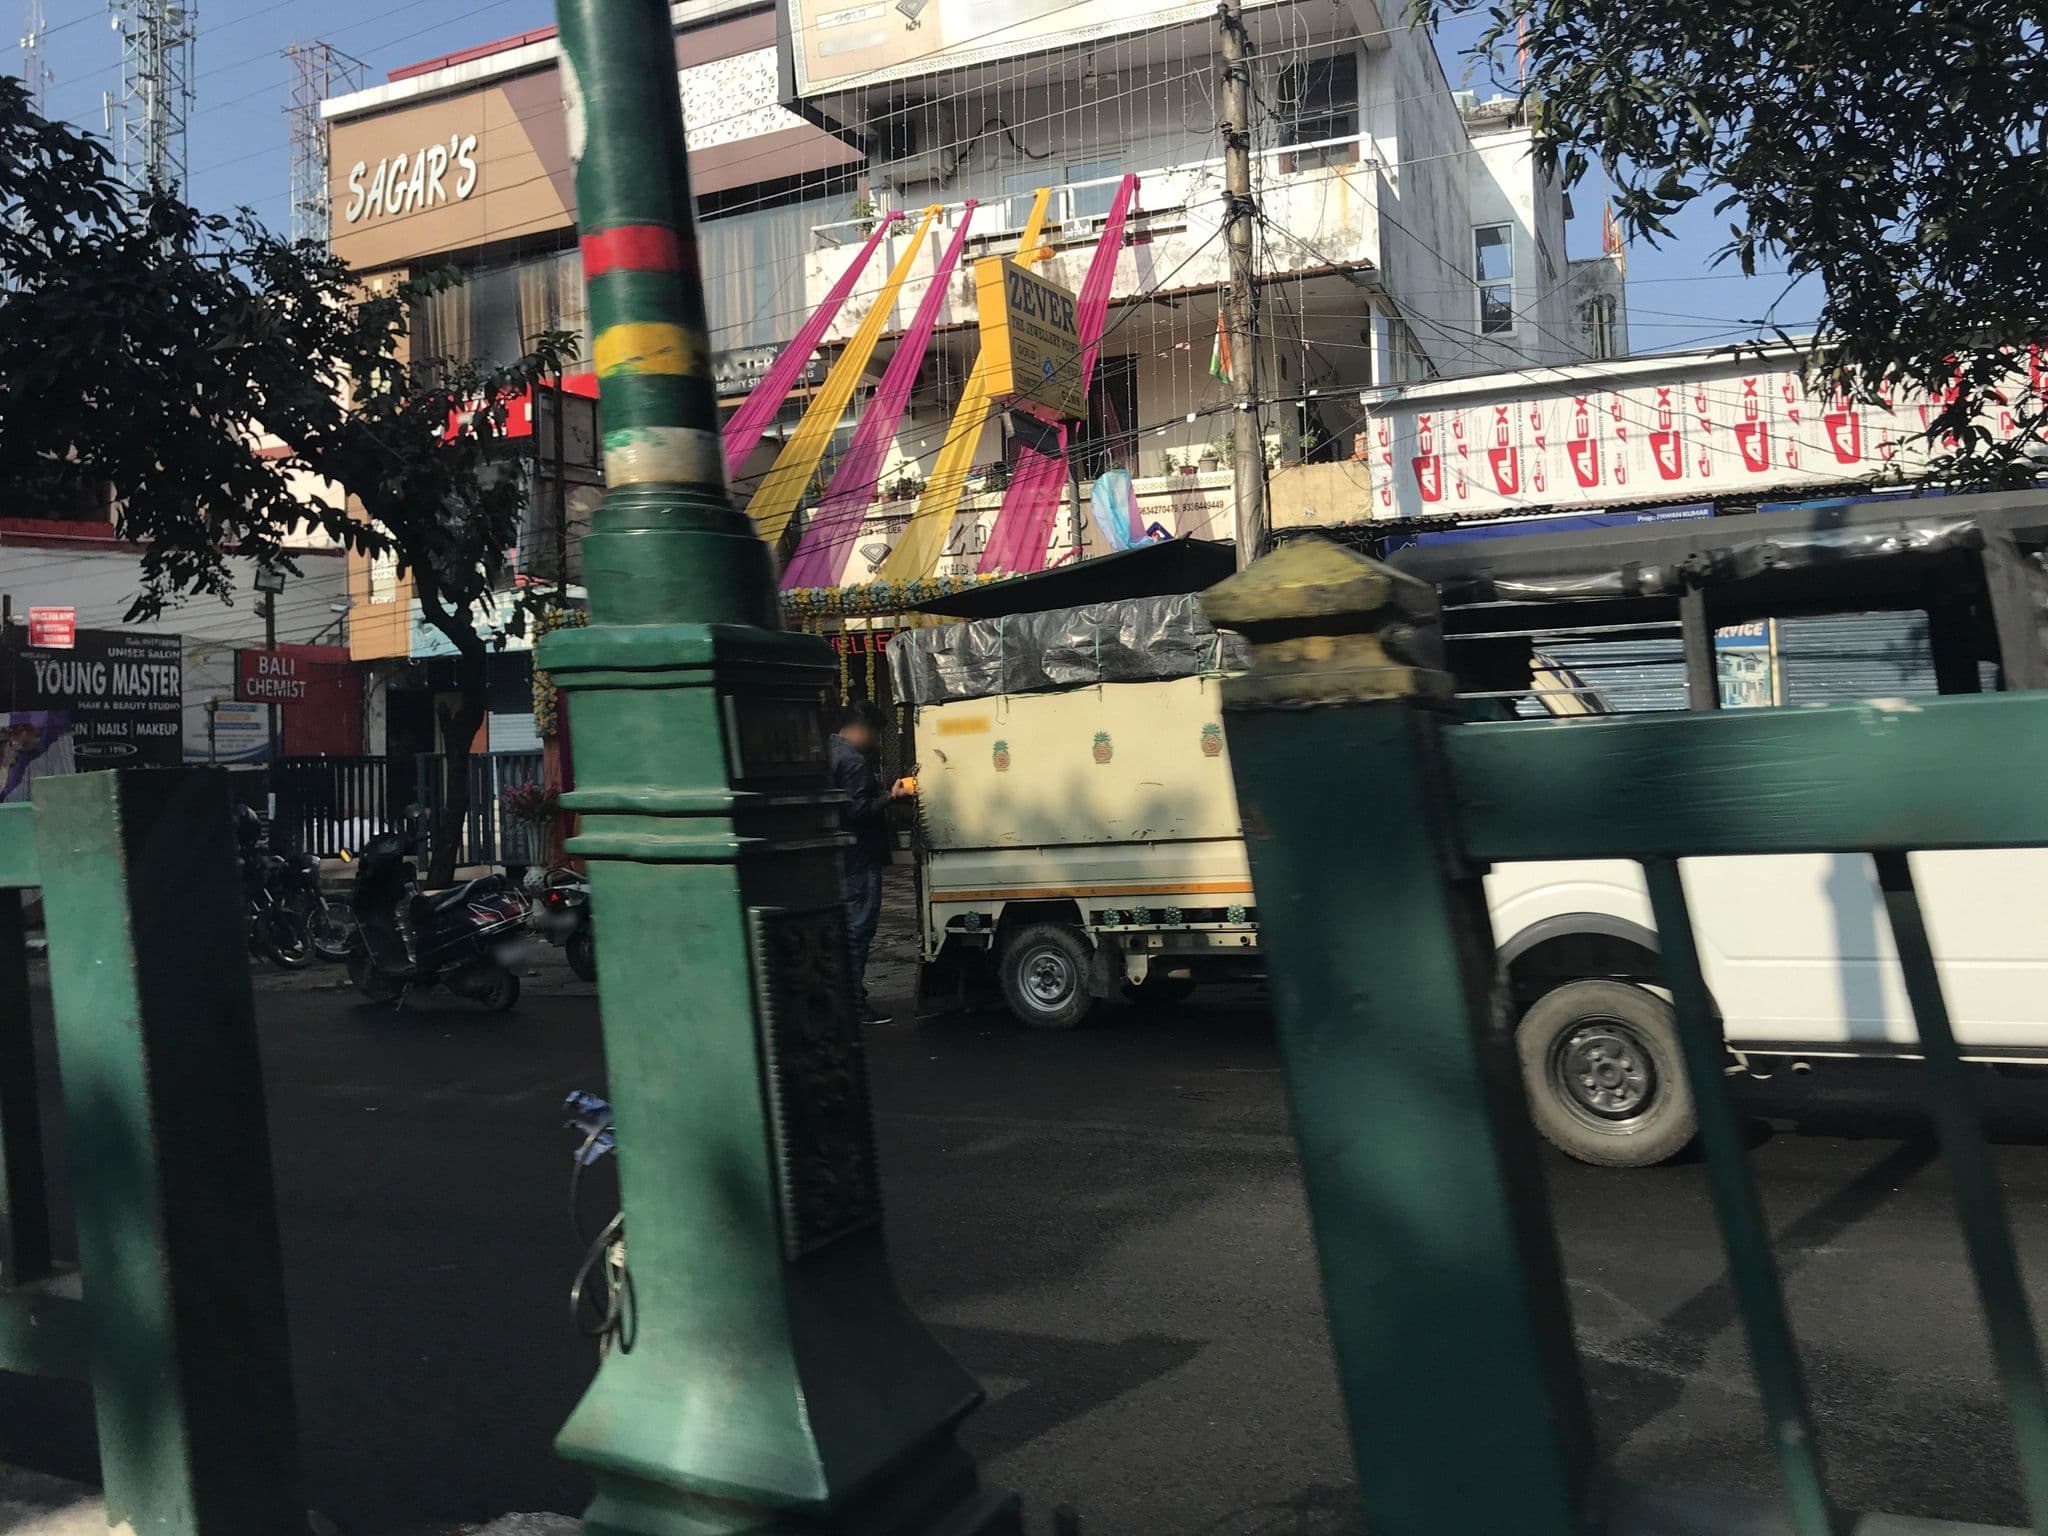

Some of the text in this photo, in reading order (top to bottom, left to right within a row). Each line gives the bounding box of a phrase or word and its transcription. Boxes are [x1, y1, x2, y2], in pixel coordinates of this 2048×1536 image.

[345, 134, 477, 223] SAGAR'S
[1009, 270, 1077, 336] ZEVER
[1492, 405, 1516, 492] ALEX
[1571, 394, 1595, 484] ALEX
[1653, 388, 1679, 477] ALEX
[1739, 378, 1766, 469] ALEX
[1416, 415, 1440, 499] ALEX
[34, 659, 180, 697] YOUNG MASTER
[107, 647, 180, 659] UNISEX SALON
[259, 655, 295, 676] BALI
[112, 701, 146, 710] BEAUTY
[246, 678, 307, 698] CHEMIST
[97, 723, 128, 736] NAILS
[136, 723, 178, 736] MAKEUP
